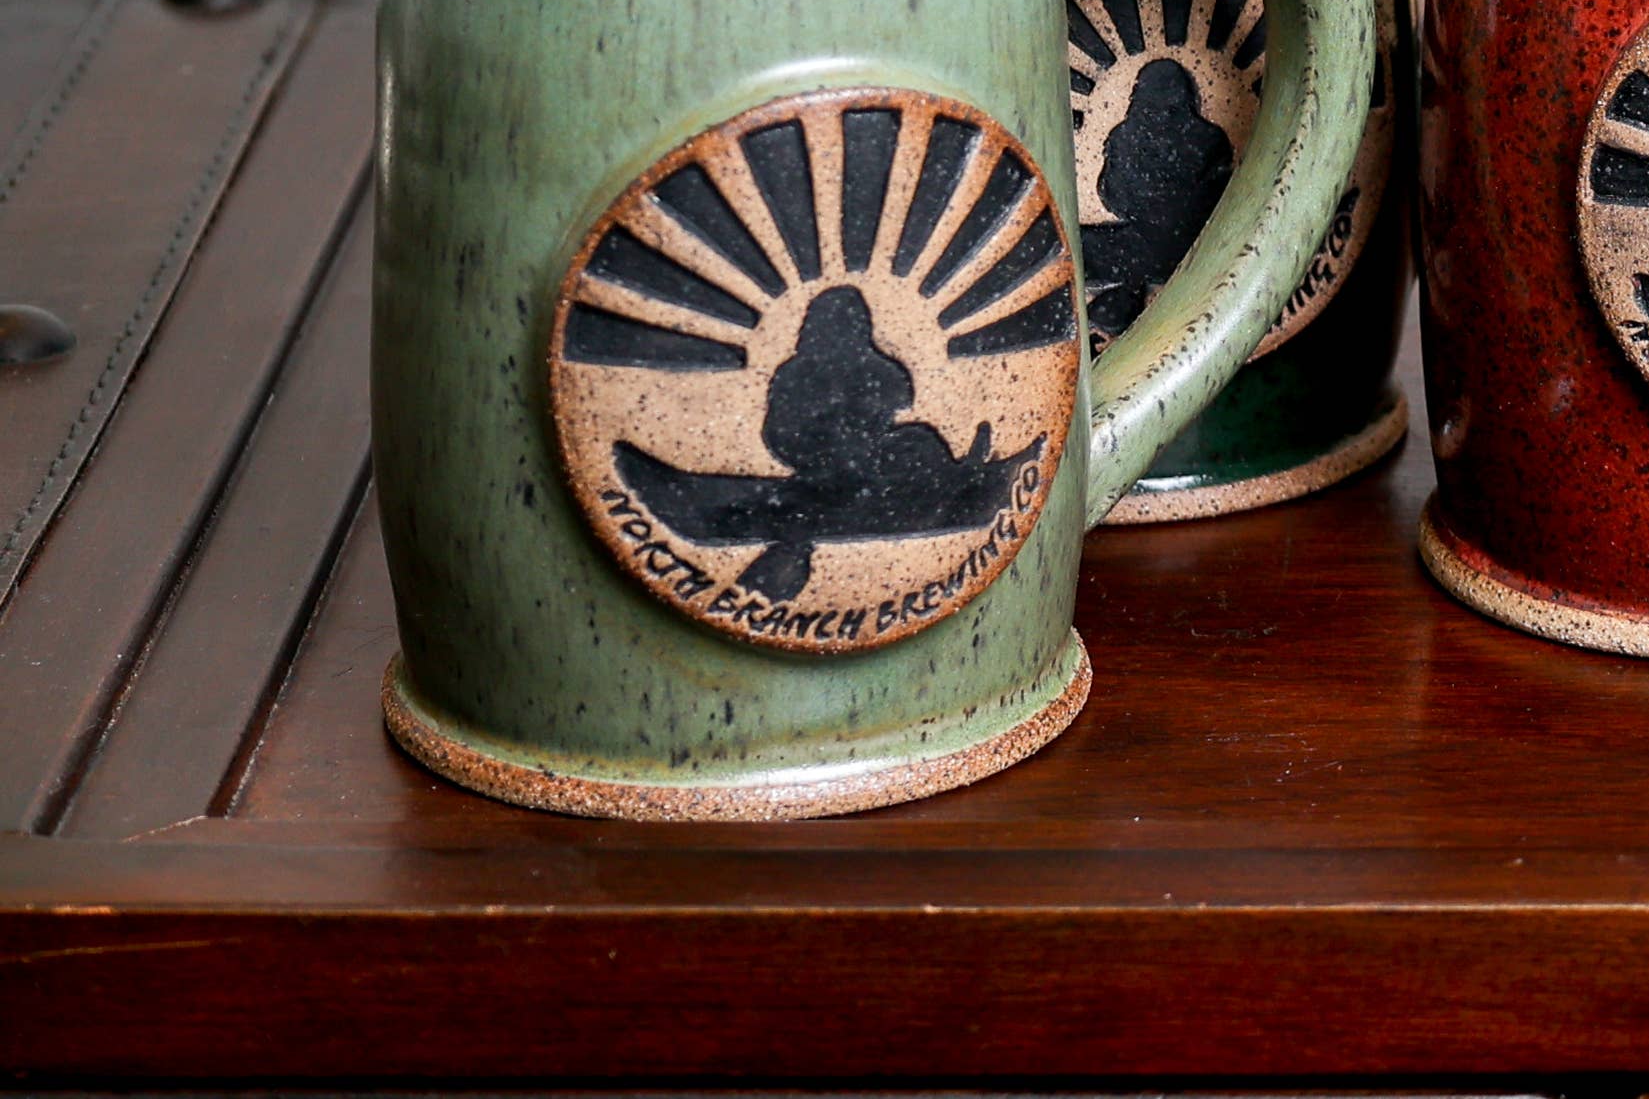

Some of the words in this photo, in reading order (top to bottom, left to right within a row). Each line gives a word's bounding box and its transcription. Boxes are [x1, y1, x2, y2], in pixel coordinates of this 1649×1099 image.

[602, 488, 714, 596] NORTH
[708, 593, 870, 640] BRANCH
[875, 514, 1017, 634] BREWING
